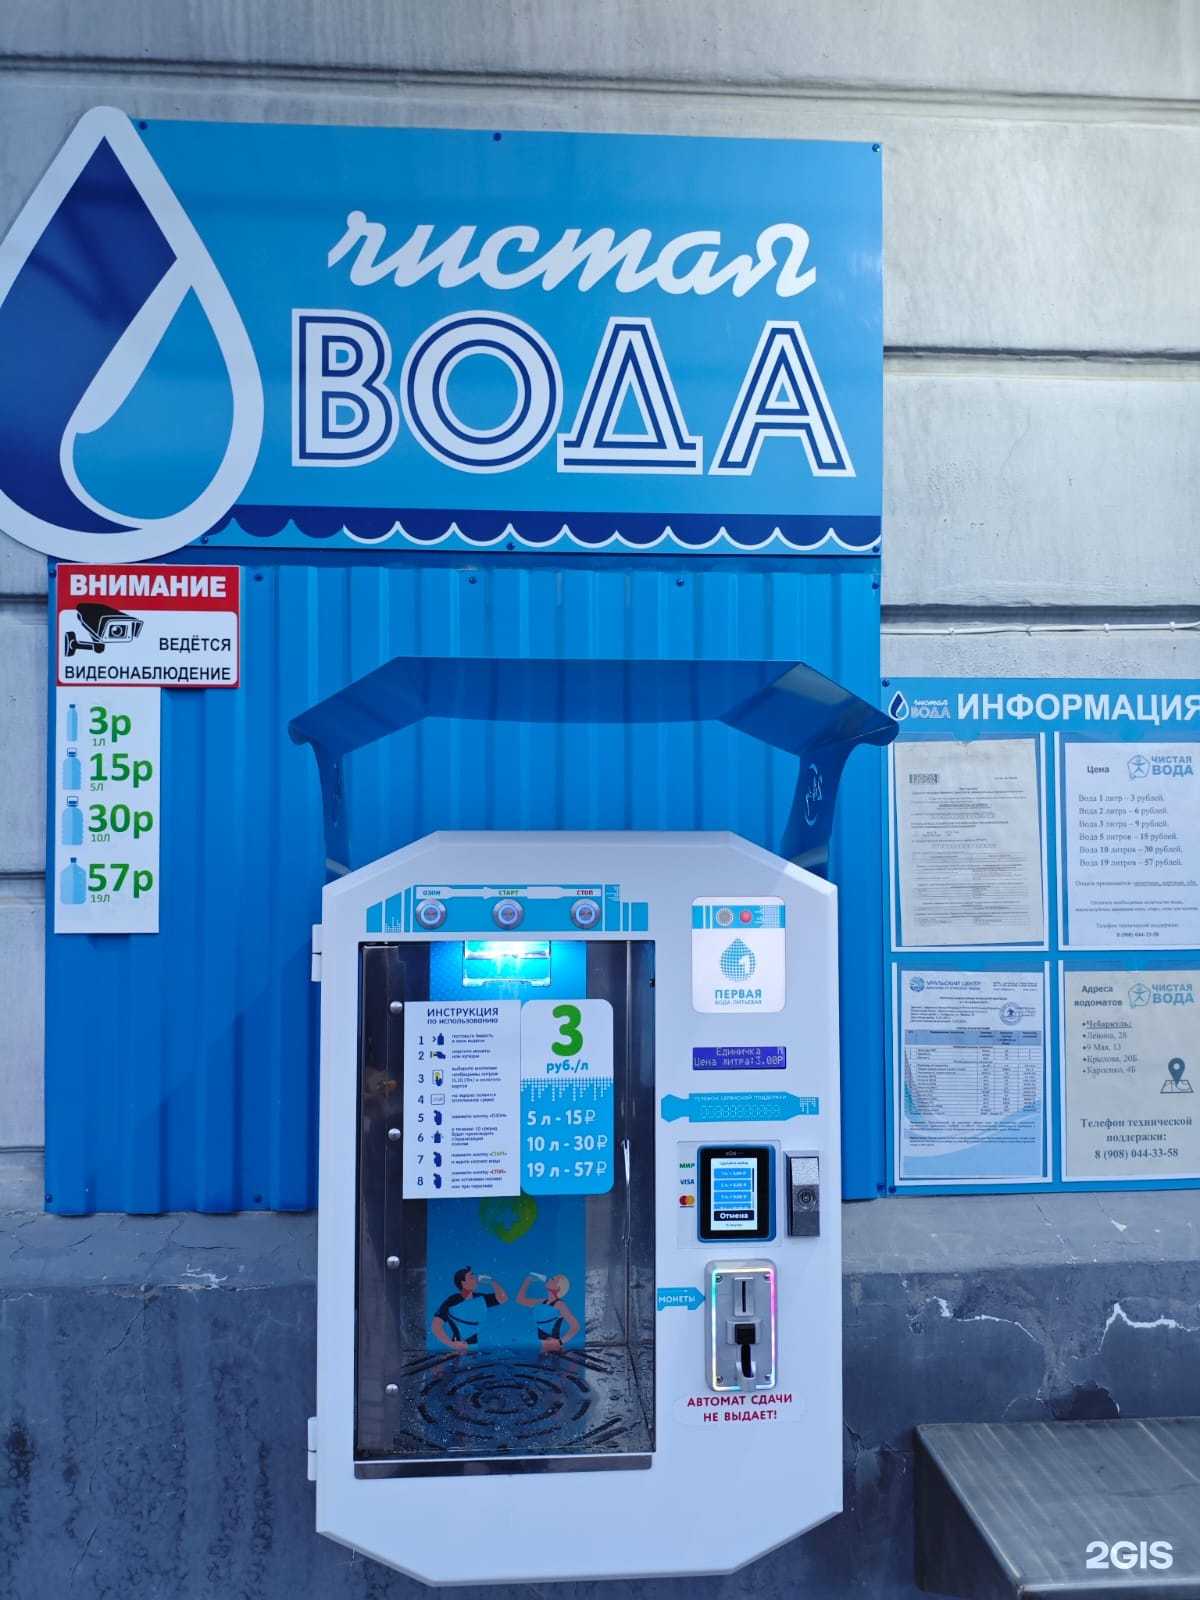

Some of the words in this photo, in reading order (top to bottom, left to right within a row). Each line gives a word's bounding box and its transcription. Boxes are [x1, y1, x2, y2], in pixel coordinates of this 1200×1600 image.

[291, 308, 857, 478] ВОДА
[70, 574, 226, 597] ВНИМАНИЕ
[159, 635, 231, 653] ВЕДЁТСЯ
[65, 665, 231, 682] ВИДЕОНАБЛЮДЕНИЕ
[911, 706, 950, 719] ВОДА
[957, 693, 1200, 725] ИНФОРМАЦИЯ
[89, 706, 132, 743] 3р
[1152, 755, 1192, 763] ЧИСТАЯ
[90, 753, 153, 788] 15р
[1087, 766, 1110, 774] Цена
[1152, 765, 1194, 777] ВОДА
[88, 804, 153, 839] 30р
[88, 864, 153, 898] 57р
[498, 889, 519, 897] СТАРТ
[1081, 985, 1114, 994] Адреса
[1151, 983, 1193, 992] ЧИСТАЯ
[715, 989, 762, 999] ПЕРВАЯ
[1152, 993, 1194, 1005] ВОДА
[1074, 1000, 1123, 1008] водоматов
[427, 1008, 499, 1017] ИНСТРУКЦИЯ
[551, 1004, 583, 1056] 3
[418, 1035, 424, 1045] 1
[418, 1051, 425, 1060] 2
[546, 1059, 589, 1073] руб./л
[418, 1074, 425, 1084] 3
[417, 1095, 424, 1105] 4
[417, 1113, 425, 1123] 5
[527, 1110, 537, 1126] 5
[541, 1115, 551, 1126] л
[1080, 1118, 1124, 1129] Телефон
[1128, 1116, 1192, 1127] технической
[417, 1133, 424, 1142] 6
[527, 1136, 545, 1151] 10
[549, 1141, 559, 1151] л
[417, 1154, 424, 1165] 7
[1094, 1150, 1101, 1159] 8
[1103, 1149, 1129, 1160] (908)
[1131, 1148, 1179, 1158] 044-33-58
[527, 1162, 545, 1177] 19
[549, 1167, 559, 1177] л
[417, 1176, 424, 1186] 8
[720, 1212, 749, 1220] Отмена
[658, 1295, 696, 1303] МОНЕТЫ
[687, 1395, 746, 1407] АВТОМАТ
[751, 1393, 793, 1405] СДАЧИ
[703, 1412, 719, 1422] НЕ
[724, 1410, 777, 1422] ВЫДАЕТ!
